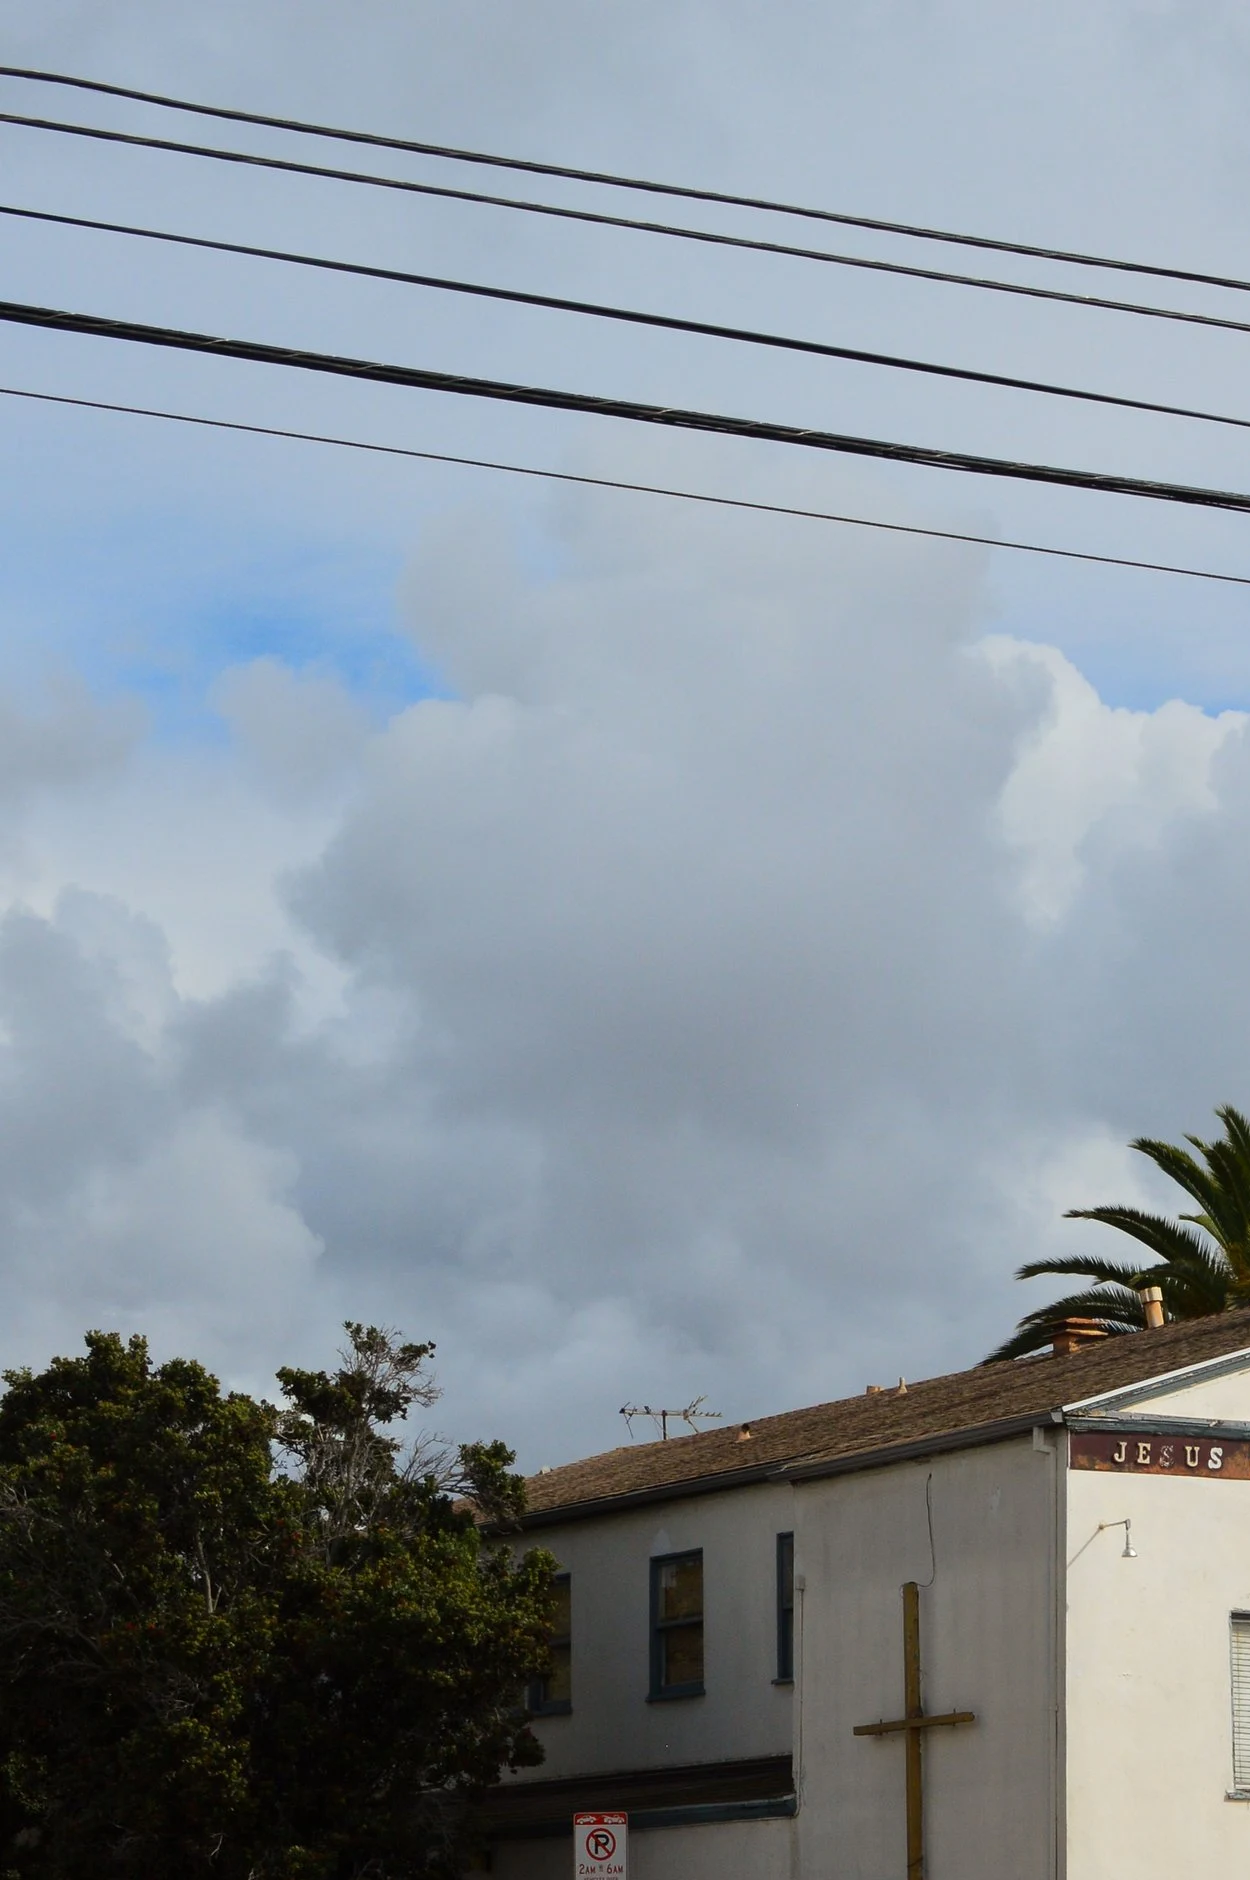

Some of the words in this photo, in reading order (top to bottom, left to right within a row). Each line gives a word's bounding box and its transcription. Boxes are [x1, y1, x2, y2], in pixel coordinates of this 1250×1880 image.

[1113, 1441, 1223, 1470] JESUS
[579, 1863, 596, 1875] 2AM
[606, 1863, 623, 1874] 6AM
